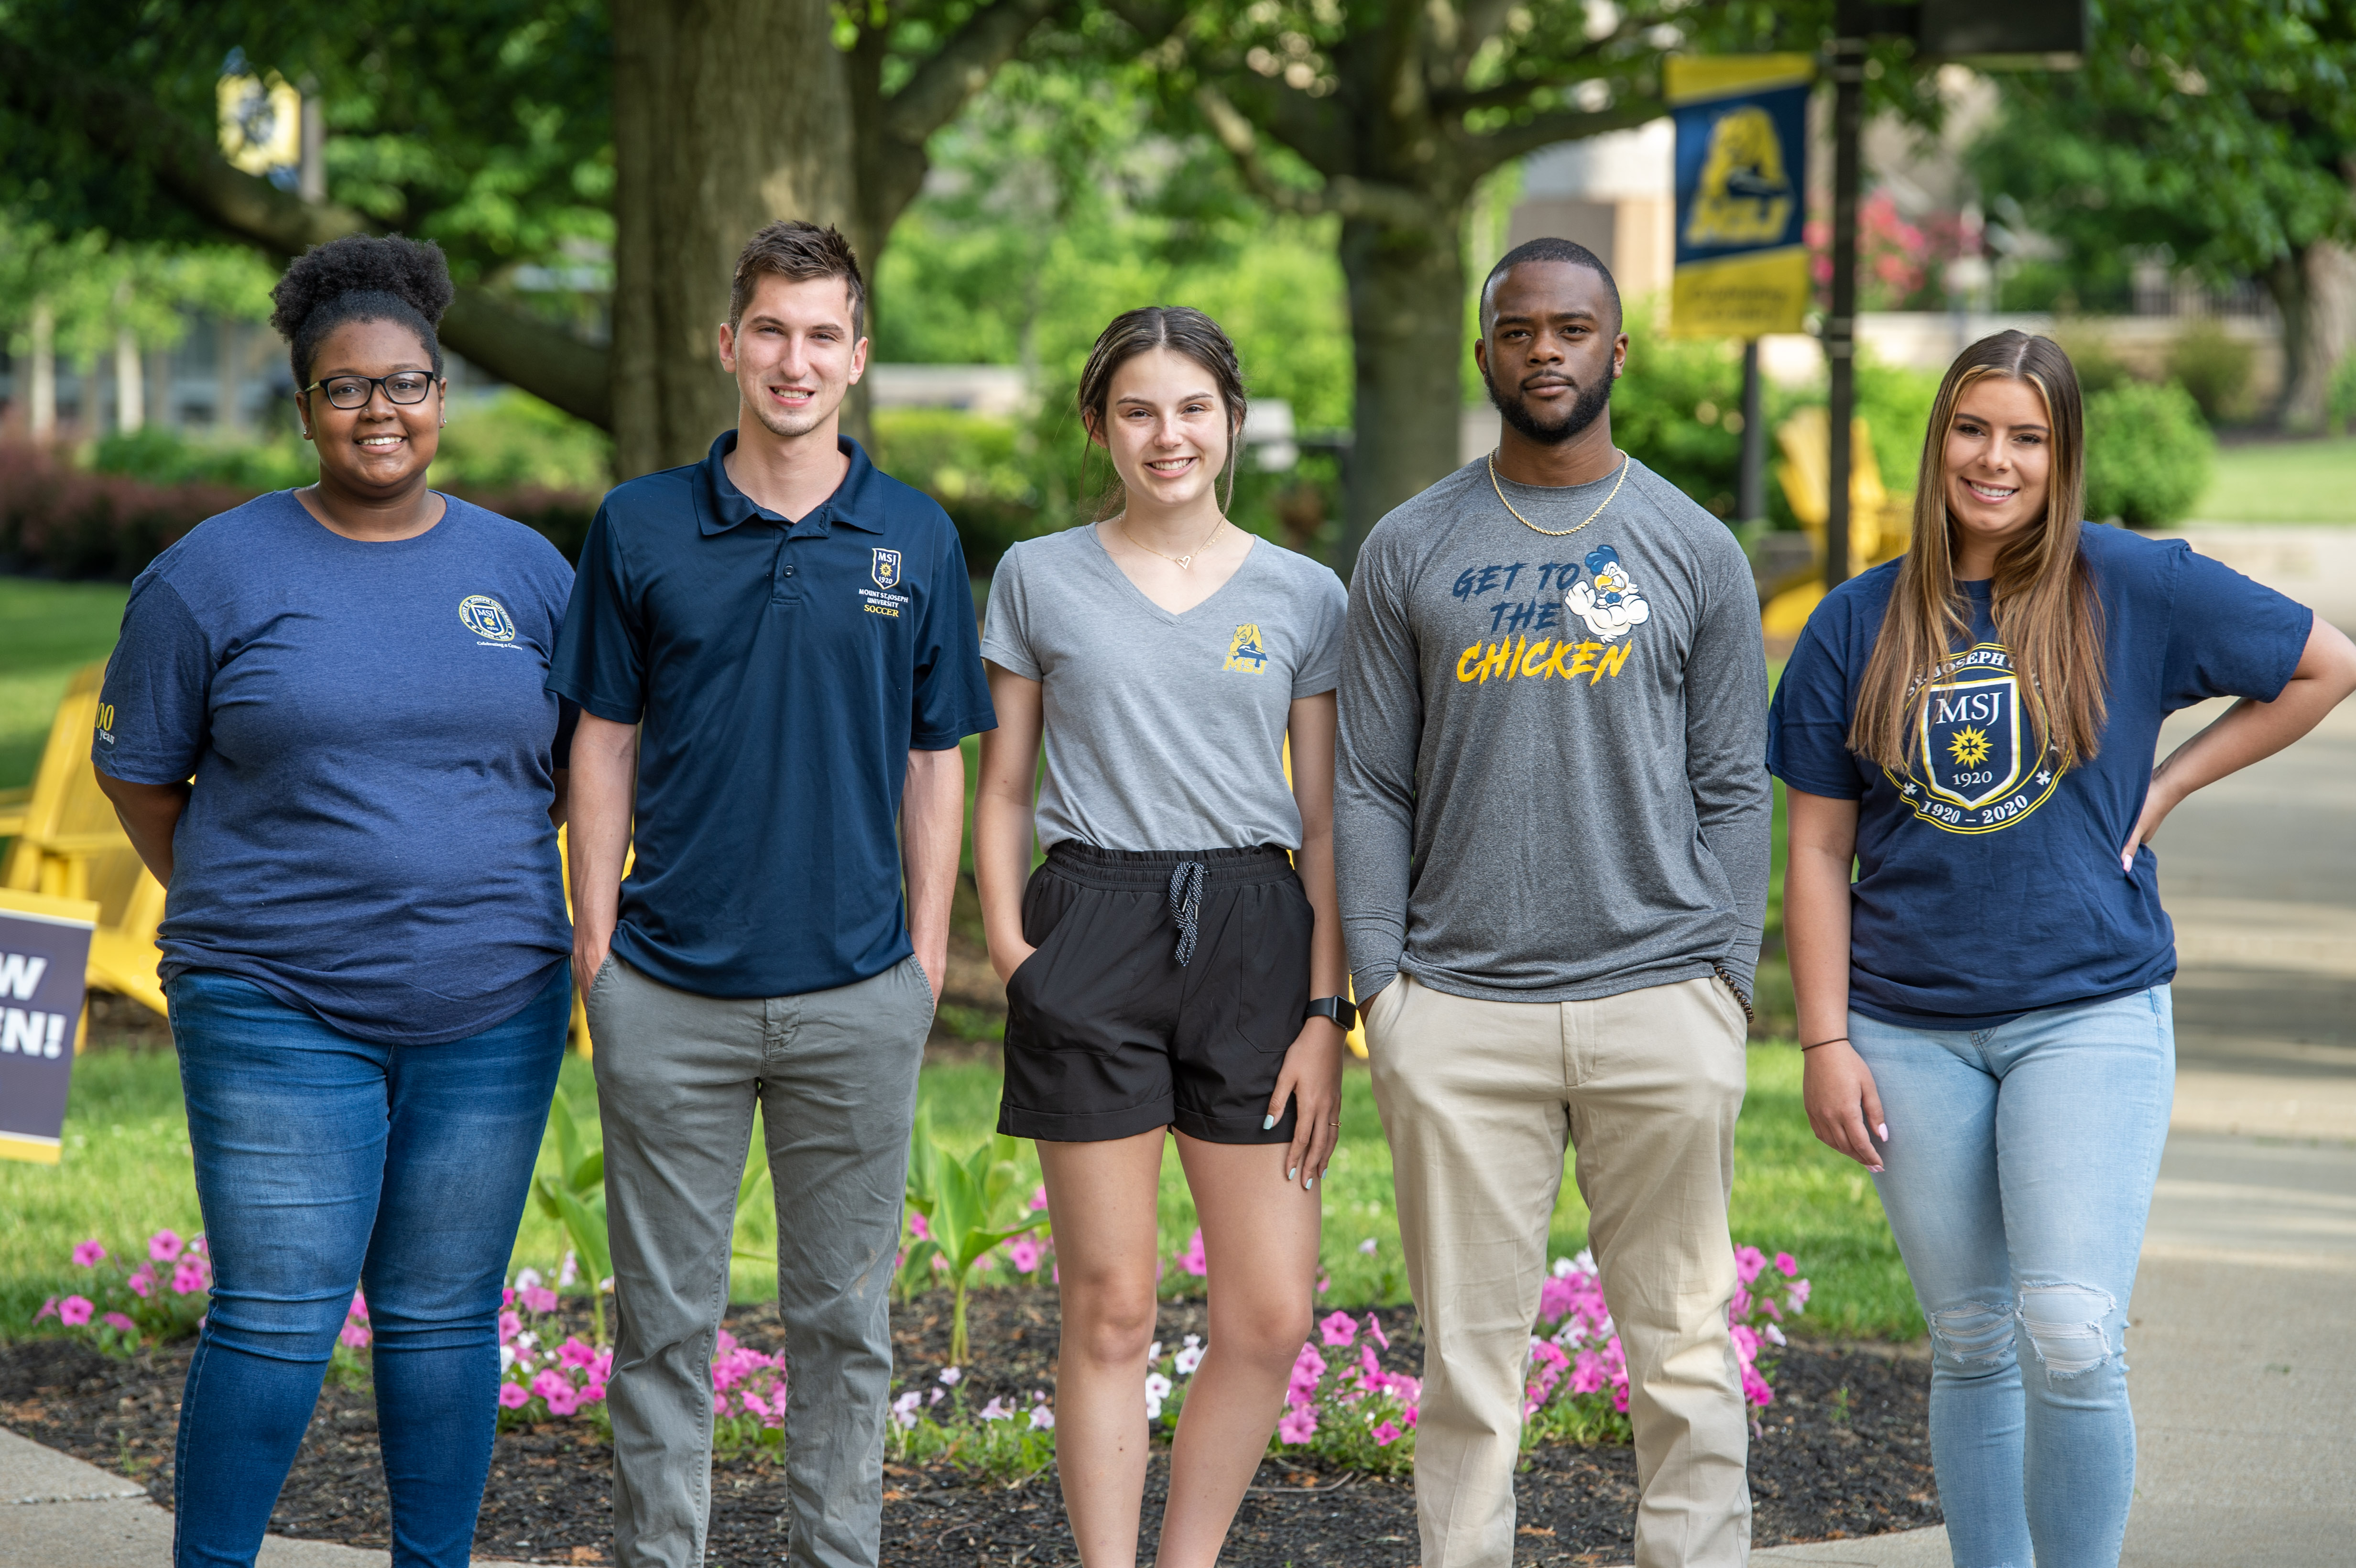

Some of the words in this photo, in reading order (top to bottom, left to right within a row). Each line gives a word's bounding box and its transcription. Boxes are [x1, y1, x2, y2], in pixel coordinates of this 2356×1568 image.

[878, 552, 897, 566] MSJ
[878, 576, 893, 584] 1920
[1453, 562, 1529, 604] GET
[1538, 561, 1580, 593] TO
[859, 588, 880, 597] MOUNT
[887, 594, 909, 603] JOSEPH
[867, 597, 899, 608] UNIVERSITY
[462, 606, 470, 622] MOUNT
[491, 601, 513, 630] UNIVERSITY
[476, 609, 494, 619] MSJ
[863, 604, 899, 617] SOCCER
[1490, 599, 1562, 635] THE
[1222, 655, 1267, 675] MSJ
[1456, 634, 1633, 686] CHICKEN
[1935, 692, 2003, 726] MSJ
[99, 729, 115, 744] years
[1952, 771, 1993, 787] 1920
[1920, 801, 1960, 824] 1920
[1983, 795, 2028, 824] 2020
